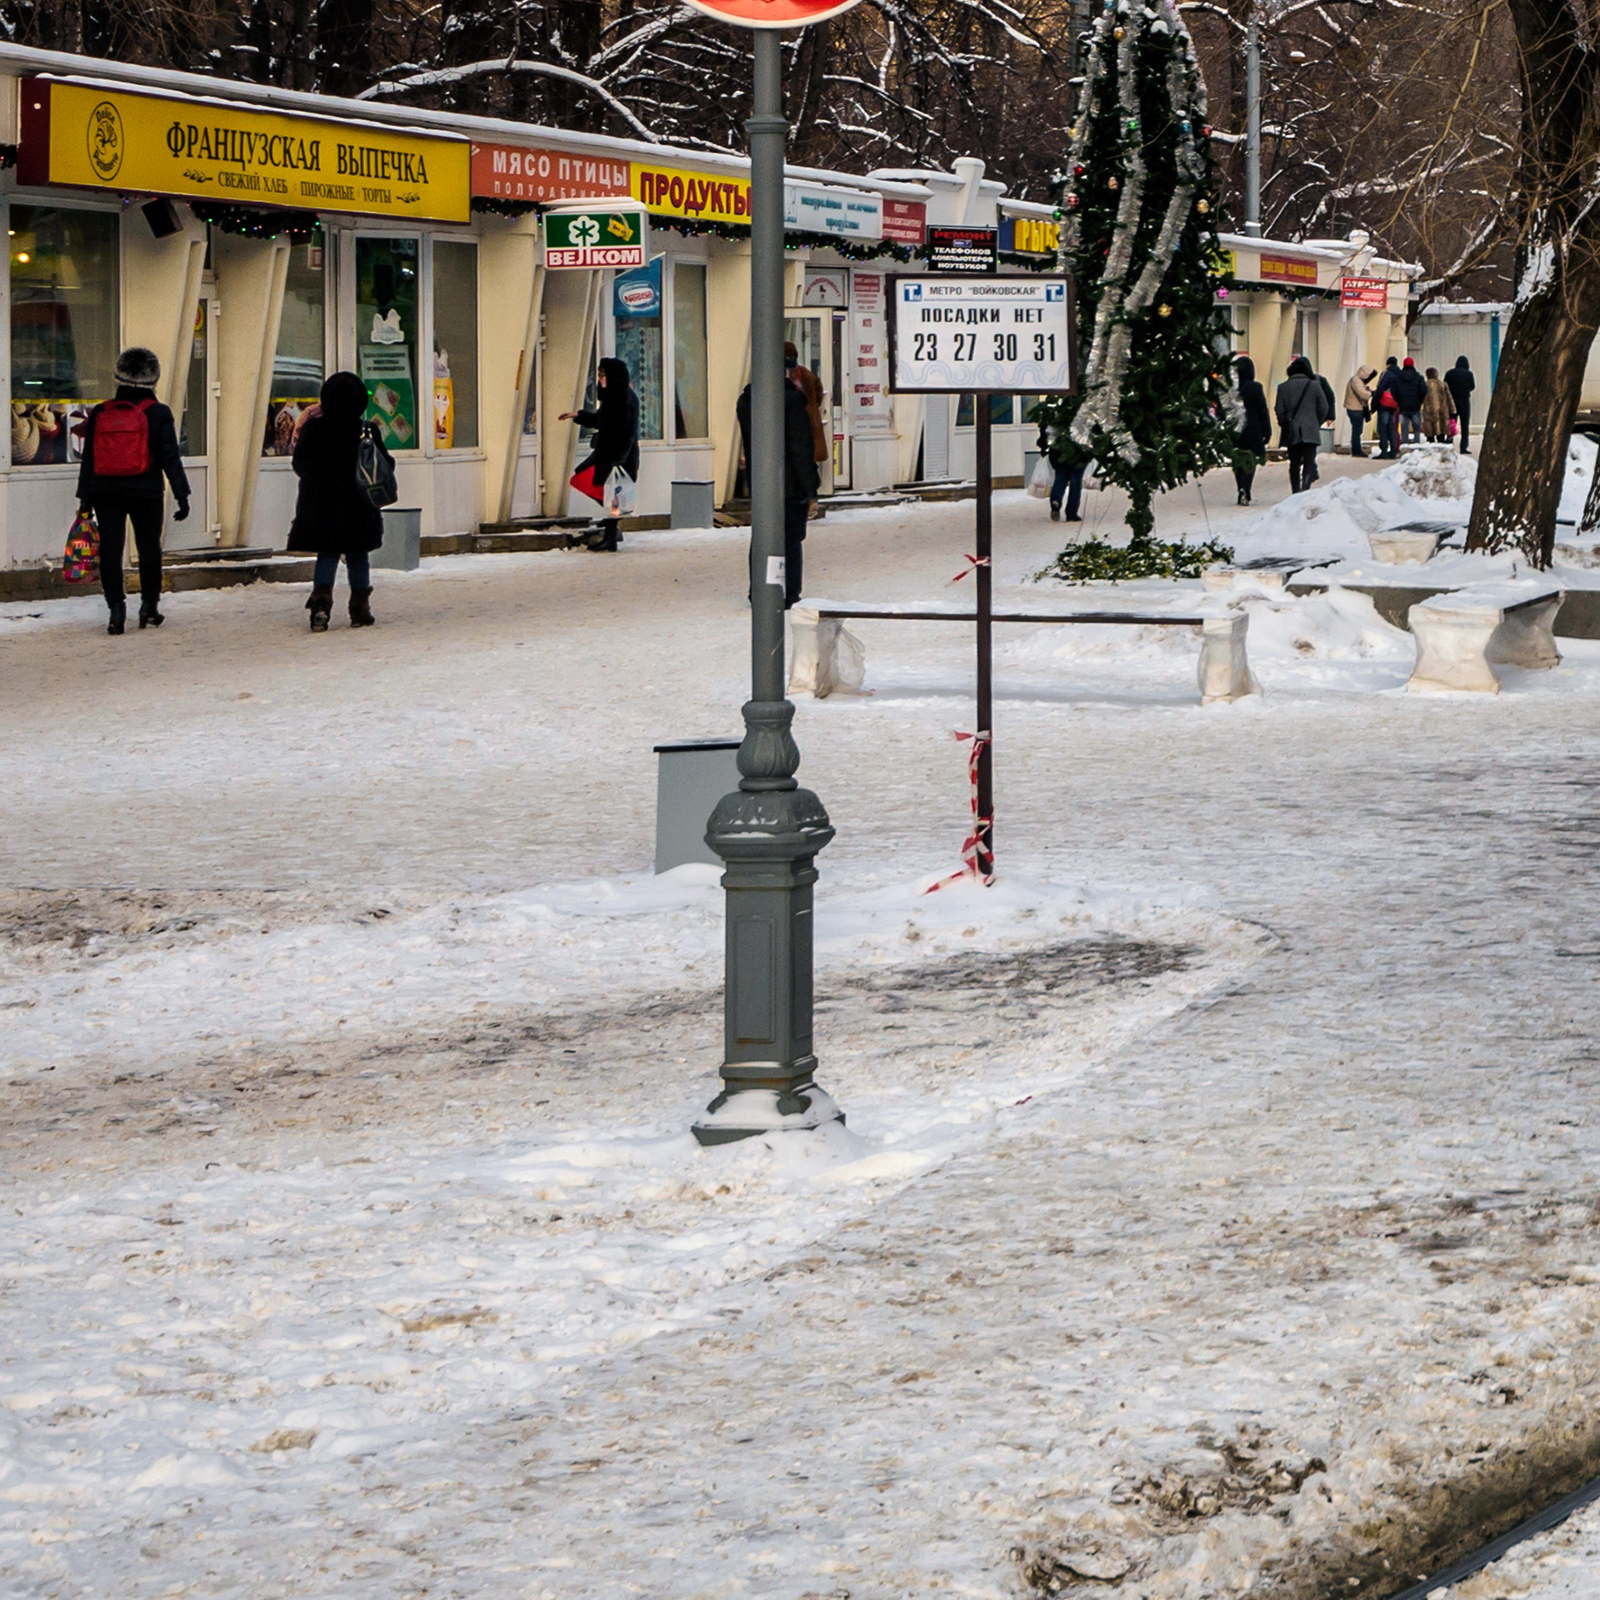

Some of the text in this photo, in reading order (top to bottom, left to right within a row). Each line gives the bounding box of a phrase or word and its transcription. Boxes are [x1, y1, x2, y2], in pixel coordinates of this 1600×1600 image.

[166, 121, 430, 184] ФРАНЦУЗСКАЯ ВЫПЕЧКА
[492, 150, 627, 189] МЯСО ПТИЦЫ
[217, 171, 392, 204] СВЕЖИЙ ХЛЕБ ПИРОЖНЫЕ ТОРТЫ
[640, 171, 752, 217] ПРОДУКТЫ
[933, 230, 993, 240] РЕМОНТ
[549, 249, 640, 266] ВЕЛКОМ
[931, 255, 994, 263] КОМПЬЮТЕРОВ
[933, 247, 991, 255] ТЕЛЕФОНОВ
[937, 262, 988, 270] НОУТБУКОВ
[929, 286, 962, 295] МЕТРО
[921, 308, 1045, 325] ПОСАДКИ НЕТ
[914, 333, 1056, 362] 23 27 30 31
